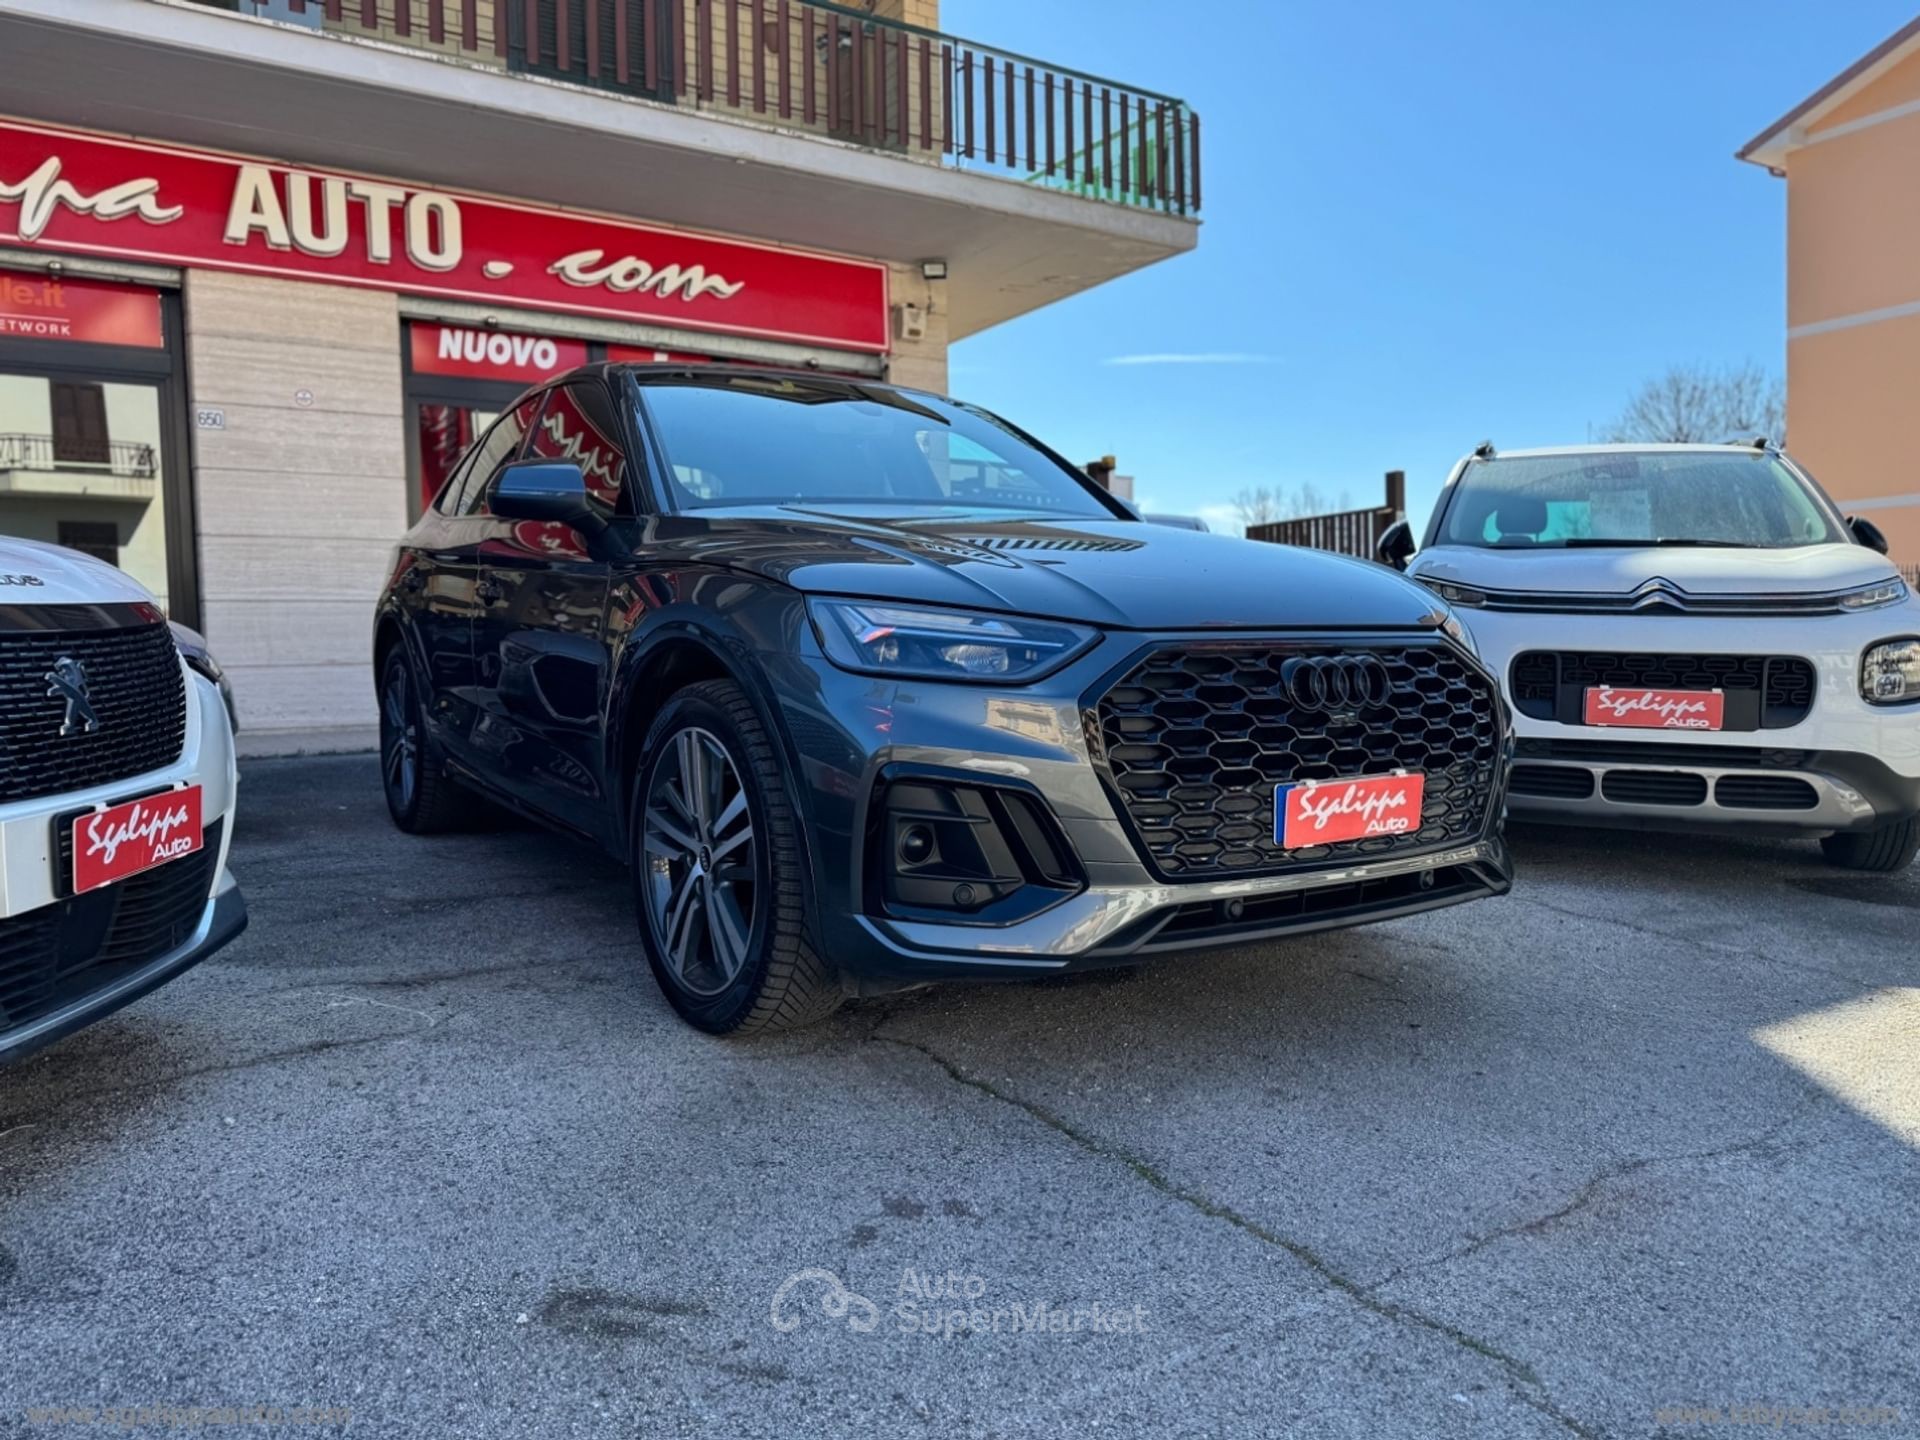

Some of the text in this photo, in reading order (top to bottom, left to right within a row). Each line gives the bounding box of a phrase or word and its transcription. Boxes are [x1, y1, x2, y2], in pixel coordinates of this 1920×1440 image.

[223, 164, 463, 272] AUTO
[438, 328, 558, 370] NUOVO
[199, 412, 222, 426] 650
[1597, 690, 1707, 717] Sgalippa
[1664, 717, 1710, 727] Auto
[1297, 784, 1407, 829] Sgalippa
[86, 804, 189, 864] Sgalippa
[1365, 817, 1409, 833] Auto
[151, 836, 192, 861] Auto
